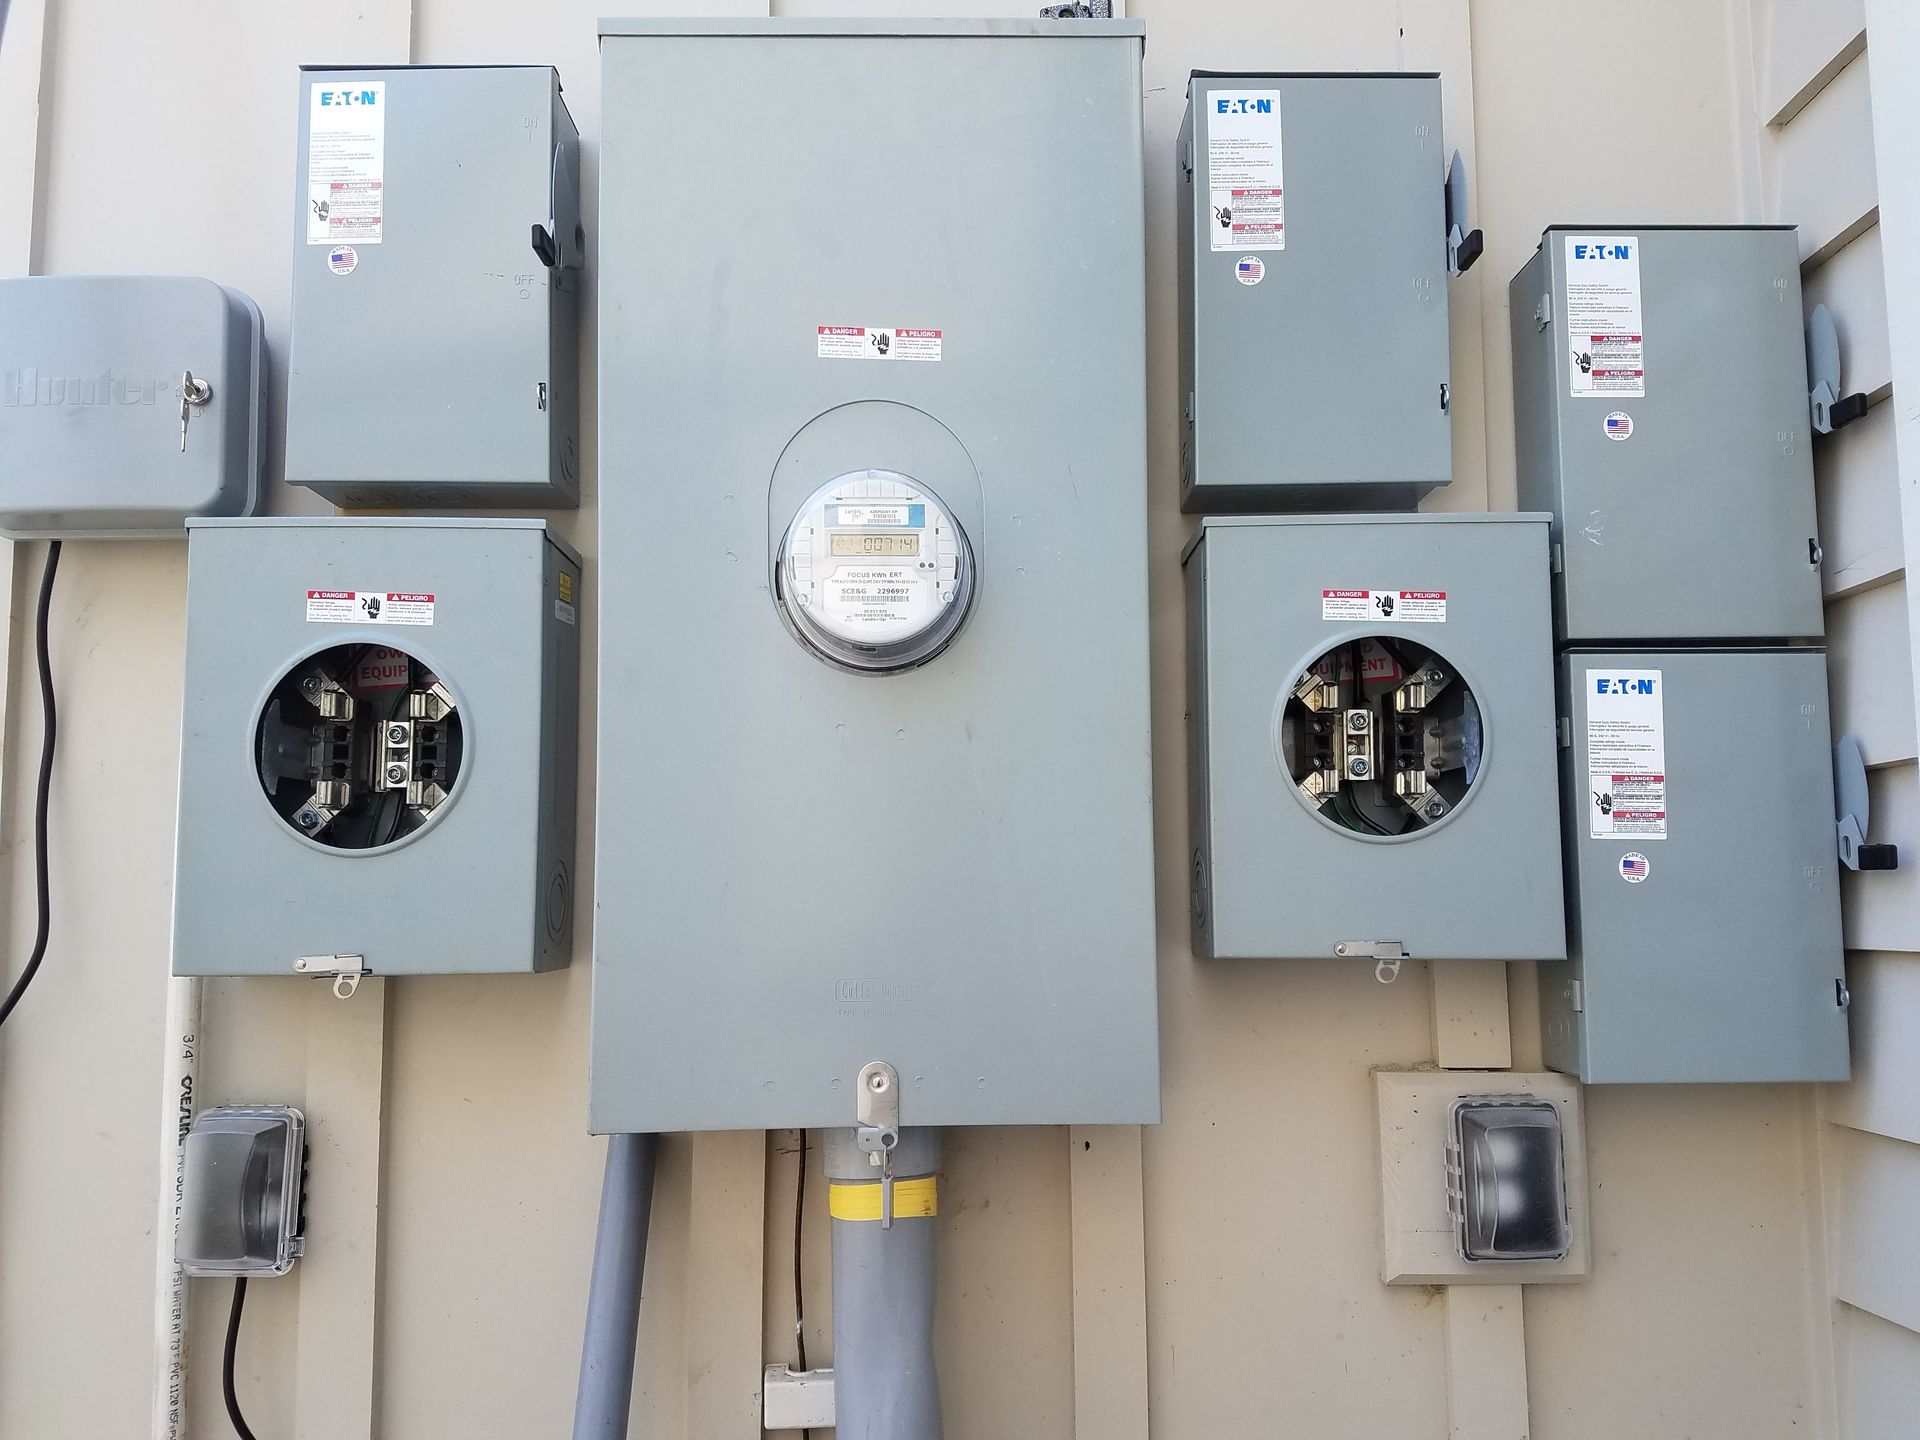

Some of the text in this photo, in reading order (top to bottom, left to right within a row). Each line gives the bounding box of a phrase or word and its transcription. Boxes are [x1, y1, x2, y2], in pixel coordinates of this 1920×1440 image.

[321, 91, 375, 106] EATON
[1217, 99, 1271, 113] EATON
[1575, 245, 1629, 259] EATON
[3, 368, 168, 407] Hunter
[864, 537, 912, 551] 00714
[362, 664, 407, 680] EQUIP
[1597, 679, 1653, 694] EATON
[182, 1034, 194, 1063] 3/4"
[174, 1270, 182, 1288] PSI
[171, 1289, 182, 1322] WATER
[171, 1324, 180, 1335] AT
[170, 1362, 179, 1381] PVC
[170, 1384, 179, 1406] 1120
[170, 1408, 178, 1425] NSF
